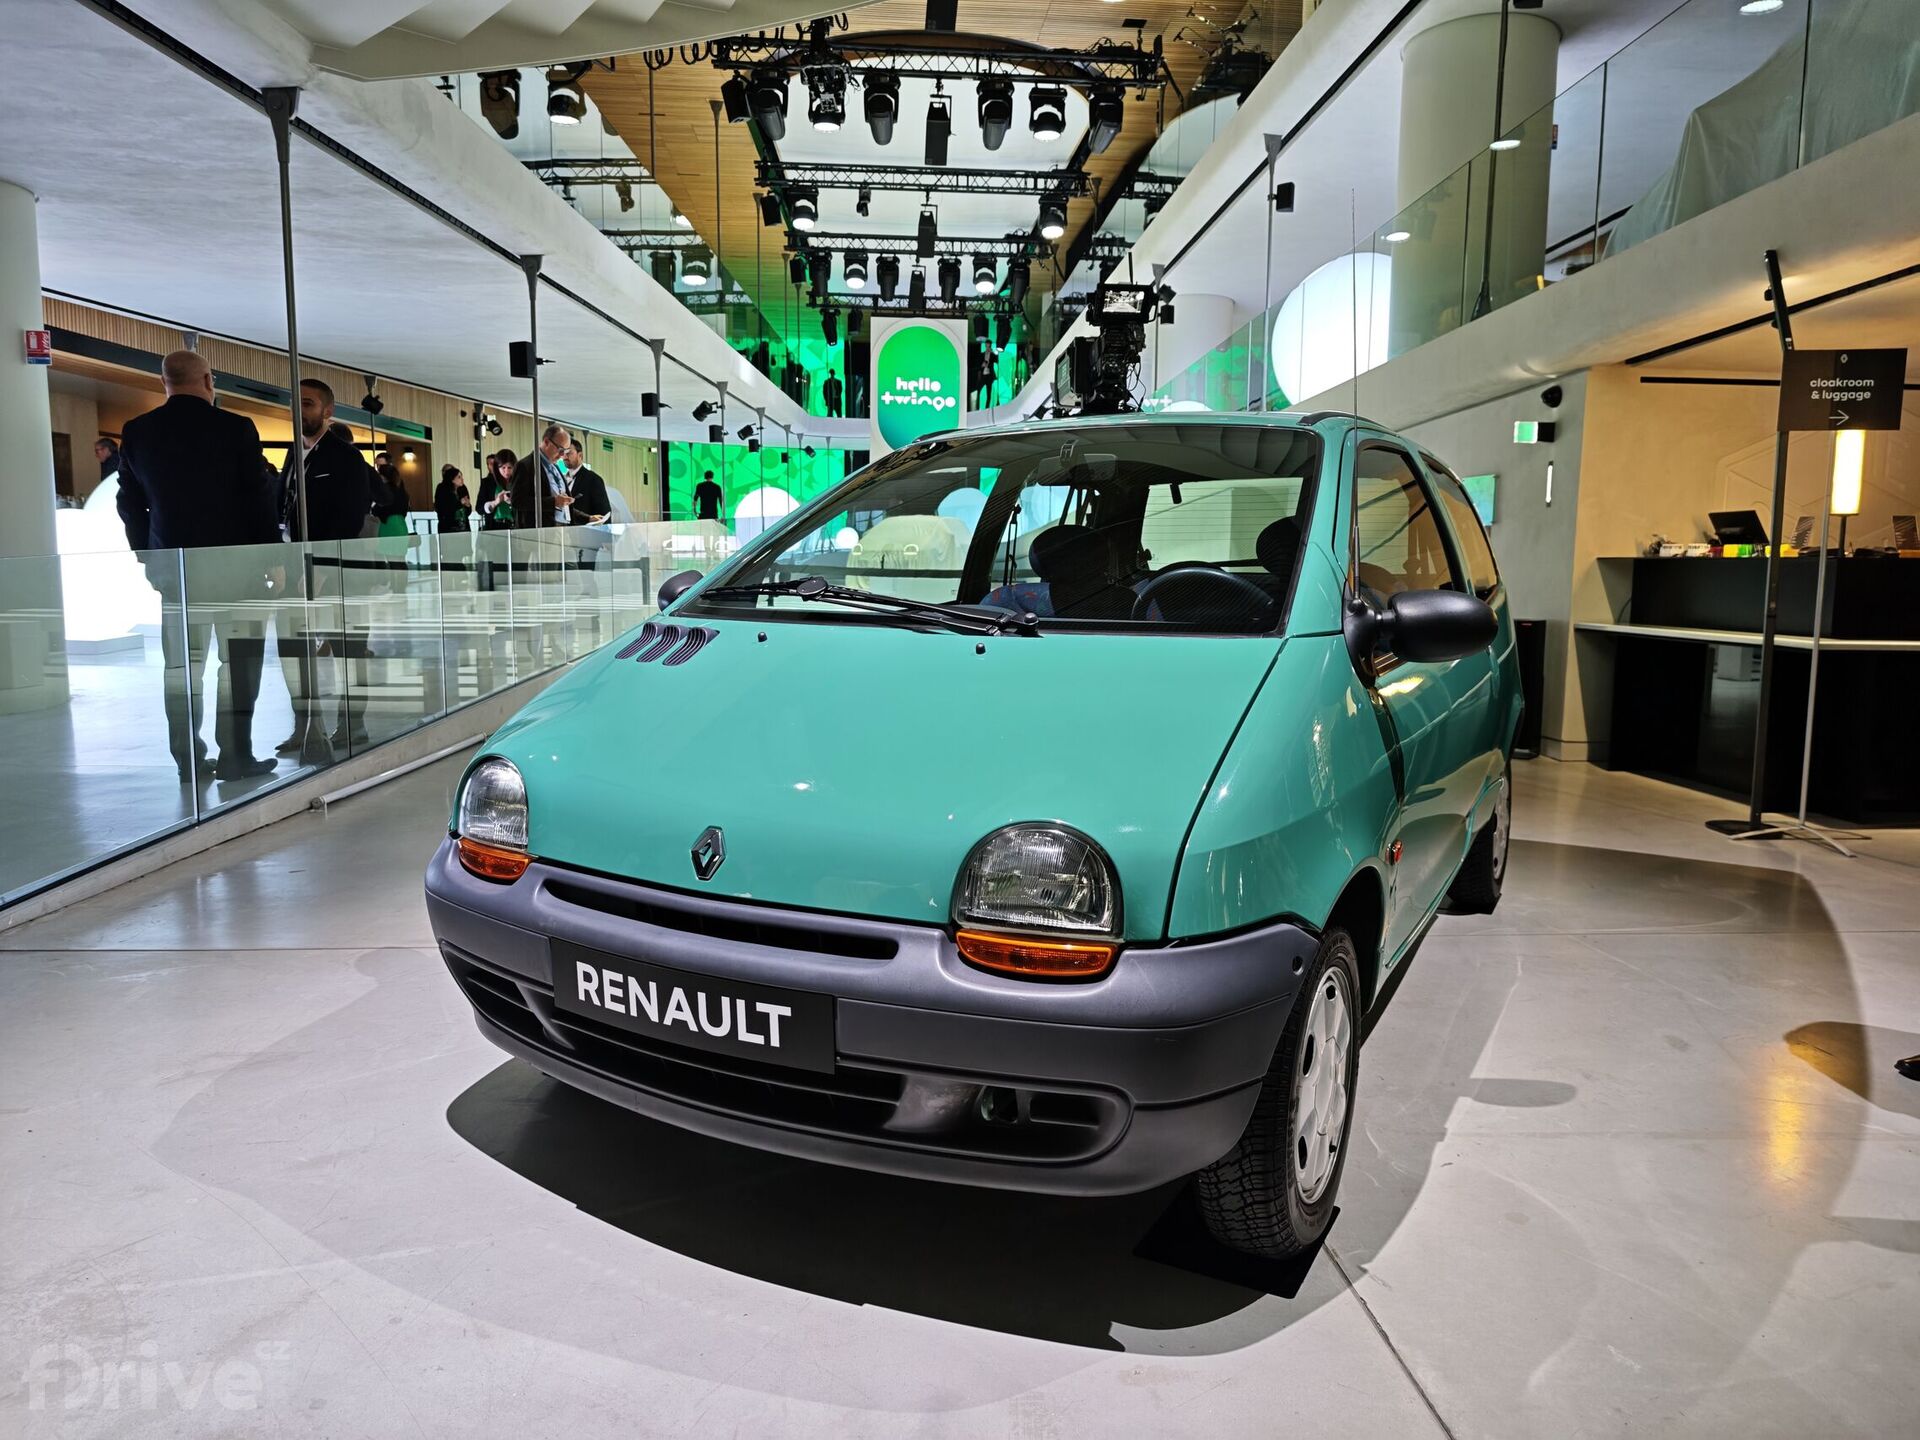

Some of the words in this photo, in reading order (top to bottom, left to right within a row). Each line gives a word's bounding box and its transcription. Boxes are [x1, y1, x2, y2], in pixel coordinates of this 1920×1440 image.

[896, 376, 941, 392] hello
[1809, 378, 1875, 388] cloakroom
[880, 391, 956, 412] twingo
[1810, 390, 1820, 400] &
[1822, 390, 1871, 401] luggage
[576, 960, 792, 1048] RENAULT
